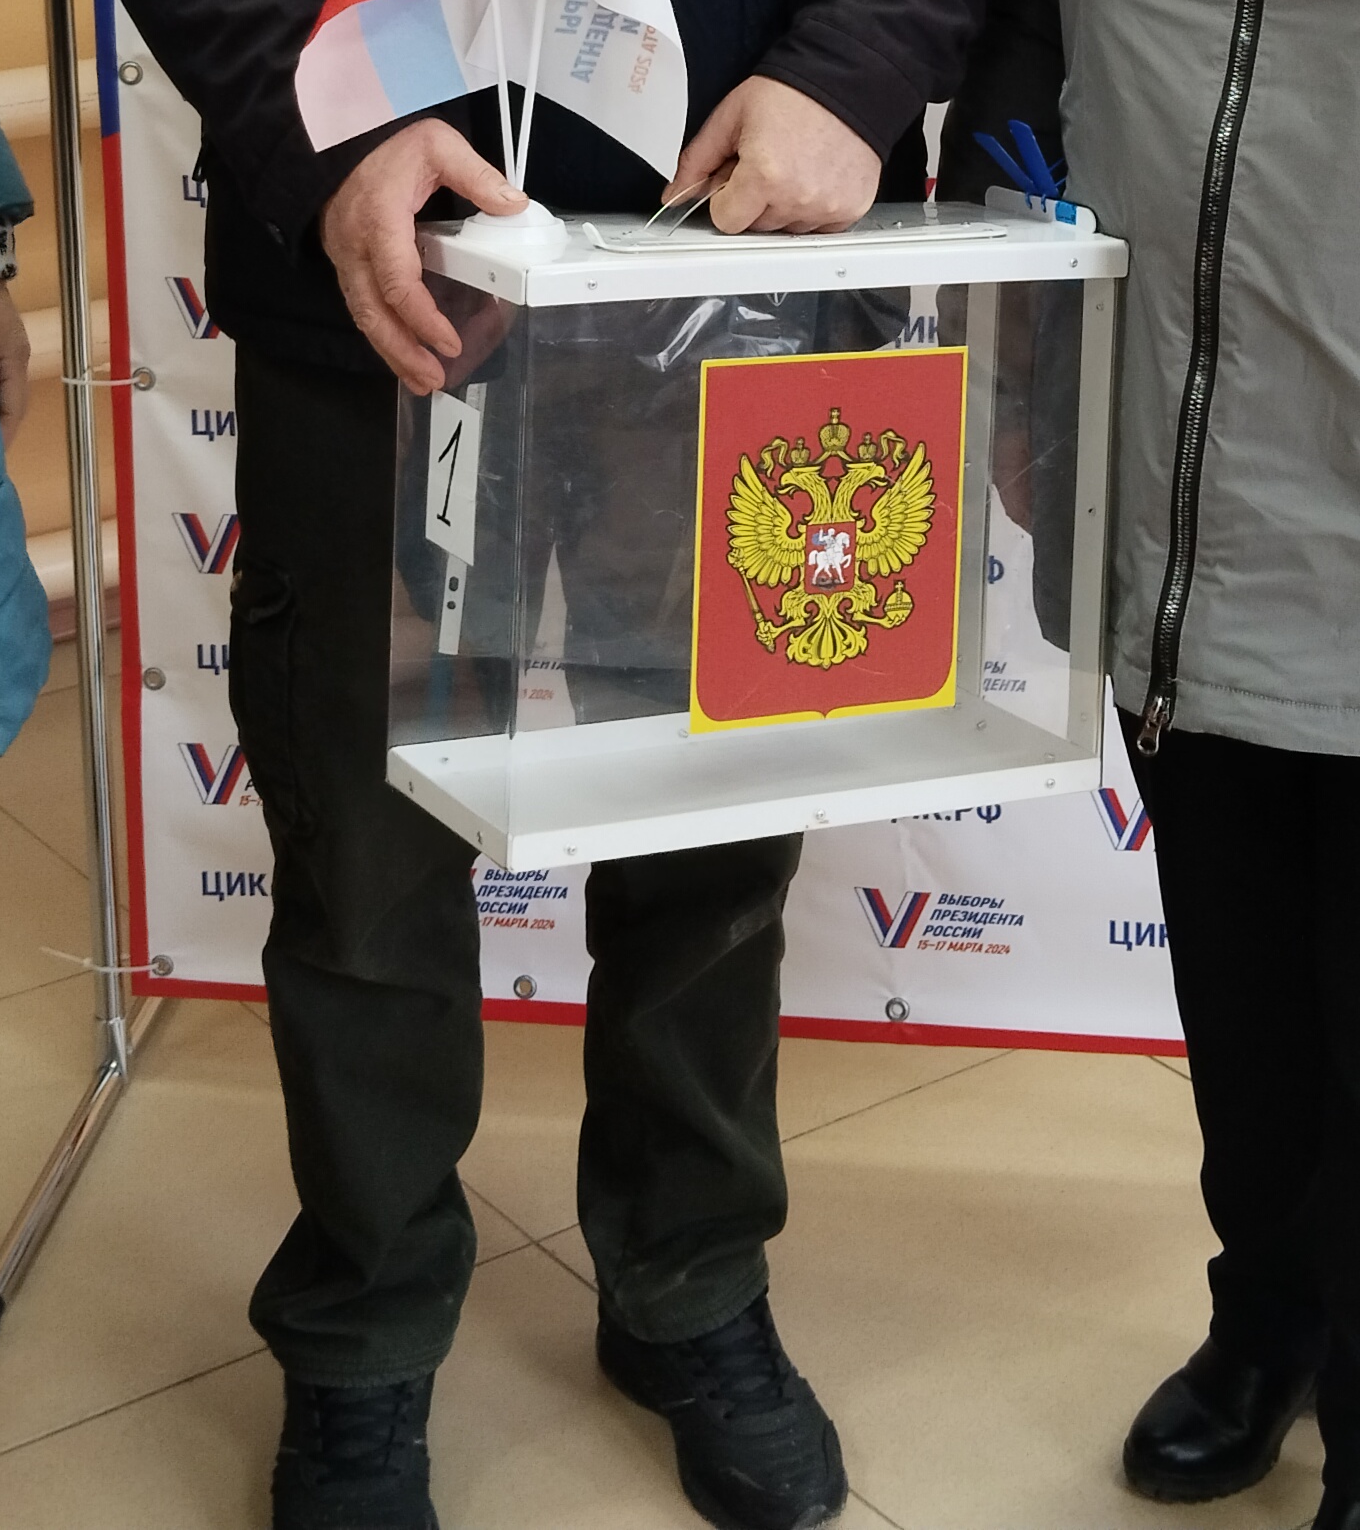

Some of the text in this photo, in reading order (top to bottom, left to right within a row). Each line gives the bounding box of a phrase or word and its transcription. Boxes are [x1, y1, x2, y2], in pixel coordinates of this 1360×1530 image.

[477, 885, 568, 899] ПРЕЗИДЕНТА
[938, 894, 1004, 909] ВЫБОРЫ
[494, 917, 529, 928] МАРТА
[530, 919, 555, 929] 2024
[930, 909, 1024, 926] ПРЕЗИДЕНТА
[922, 925, 983, 939] РОССИИ
[947, 941, 983, 953] МАРТА
[985, 944, 1011, 955] 2024
